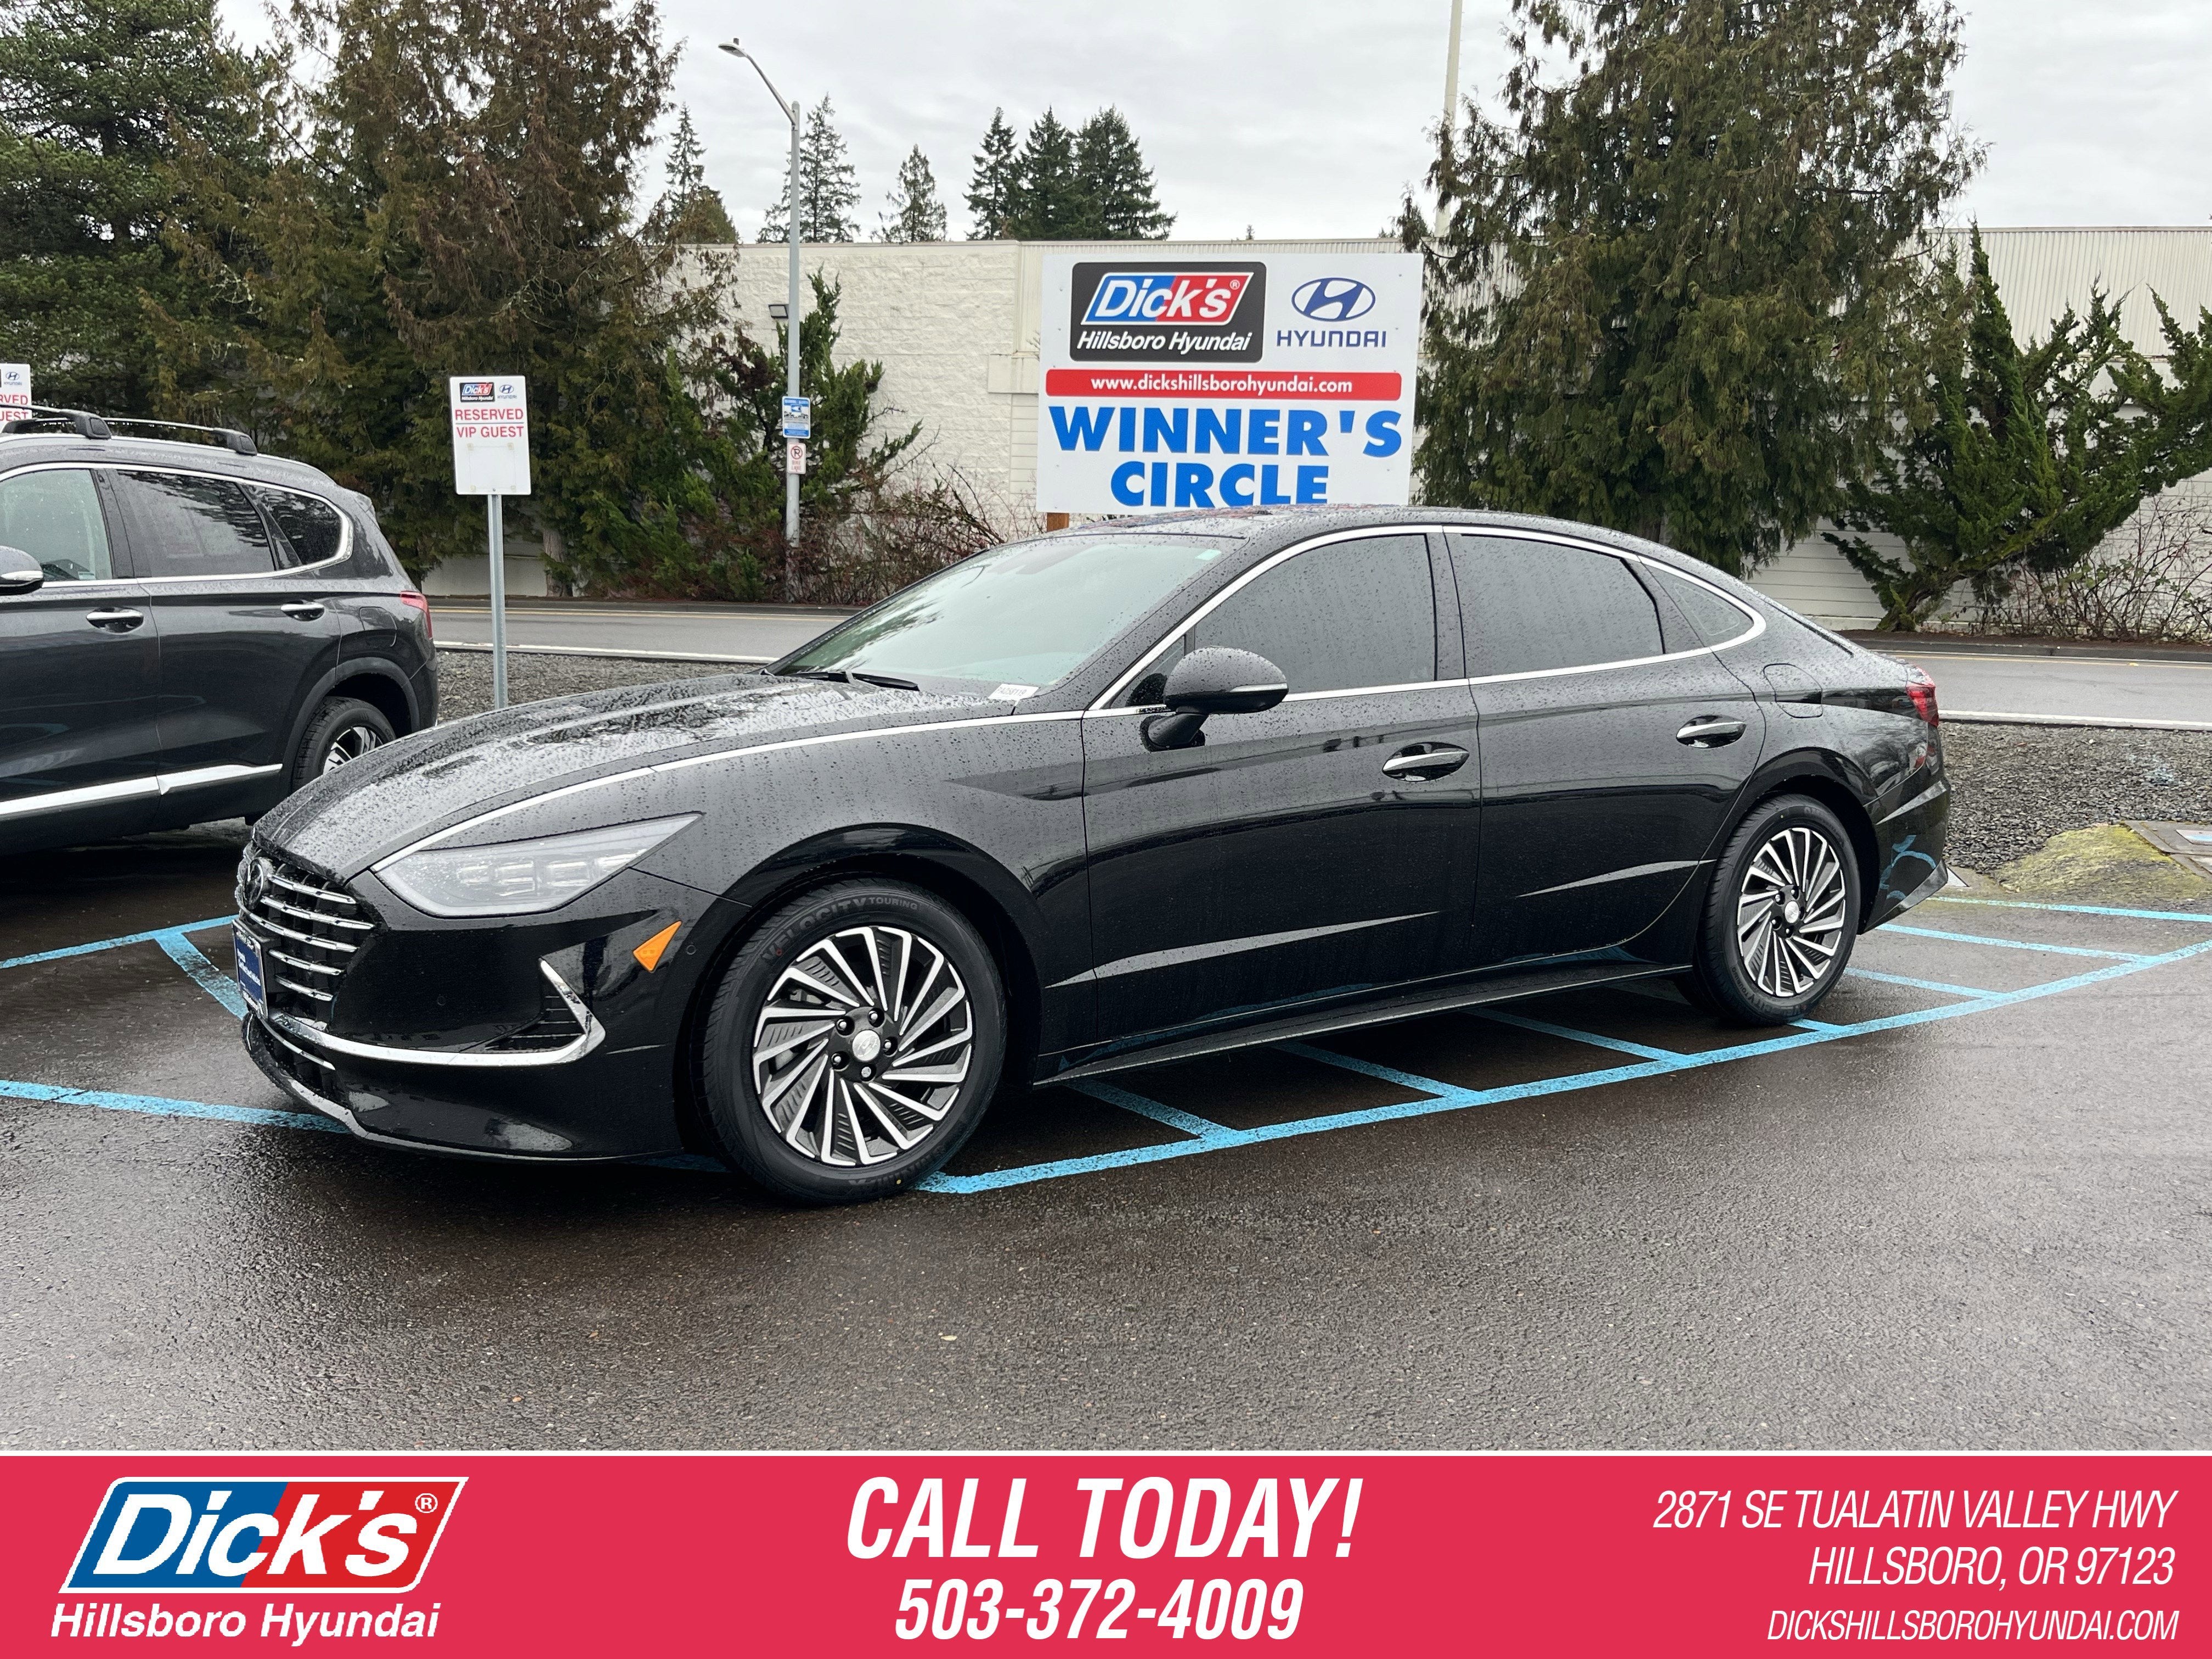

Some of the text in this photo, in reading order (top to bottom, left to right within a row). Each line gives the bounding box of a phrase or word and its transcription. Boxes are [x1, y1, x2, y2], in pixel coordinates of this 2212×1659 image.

[1077, 331, 1253, 355] Hillsboro Hyundai
[1277, 330, 1386, 347] HYUNDAI
[1091, 373, 1352, 393] www.dickshillsborohyundai.com
[455, 408, 524, 420] RESERVED
[456, 426, 524, 438] VIP GUEST
[1048, 406, 1402, 457] WINNER'S
[1110, 461, 1329, 508] CIRCLE
[762, 896, 918, 961] VELOCITY TOURING
